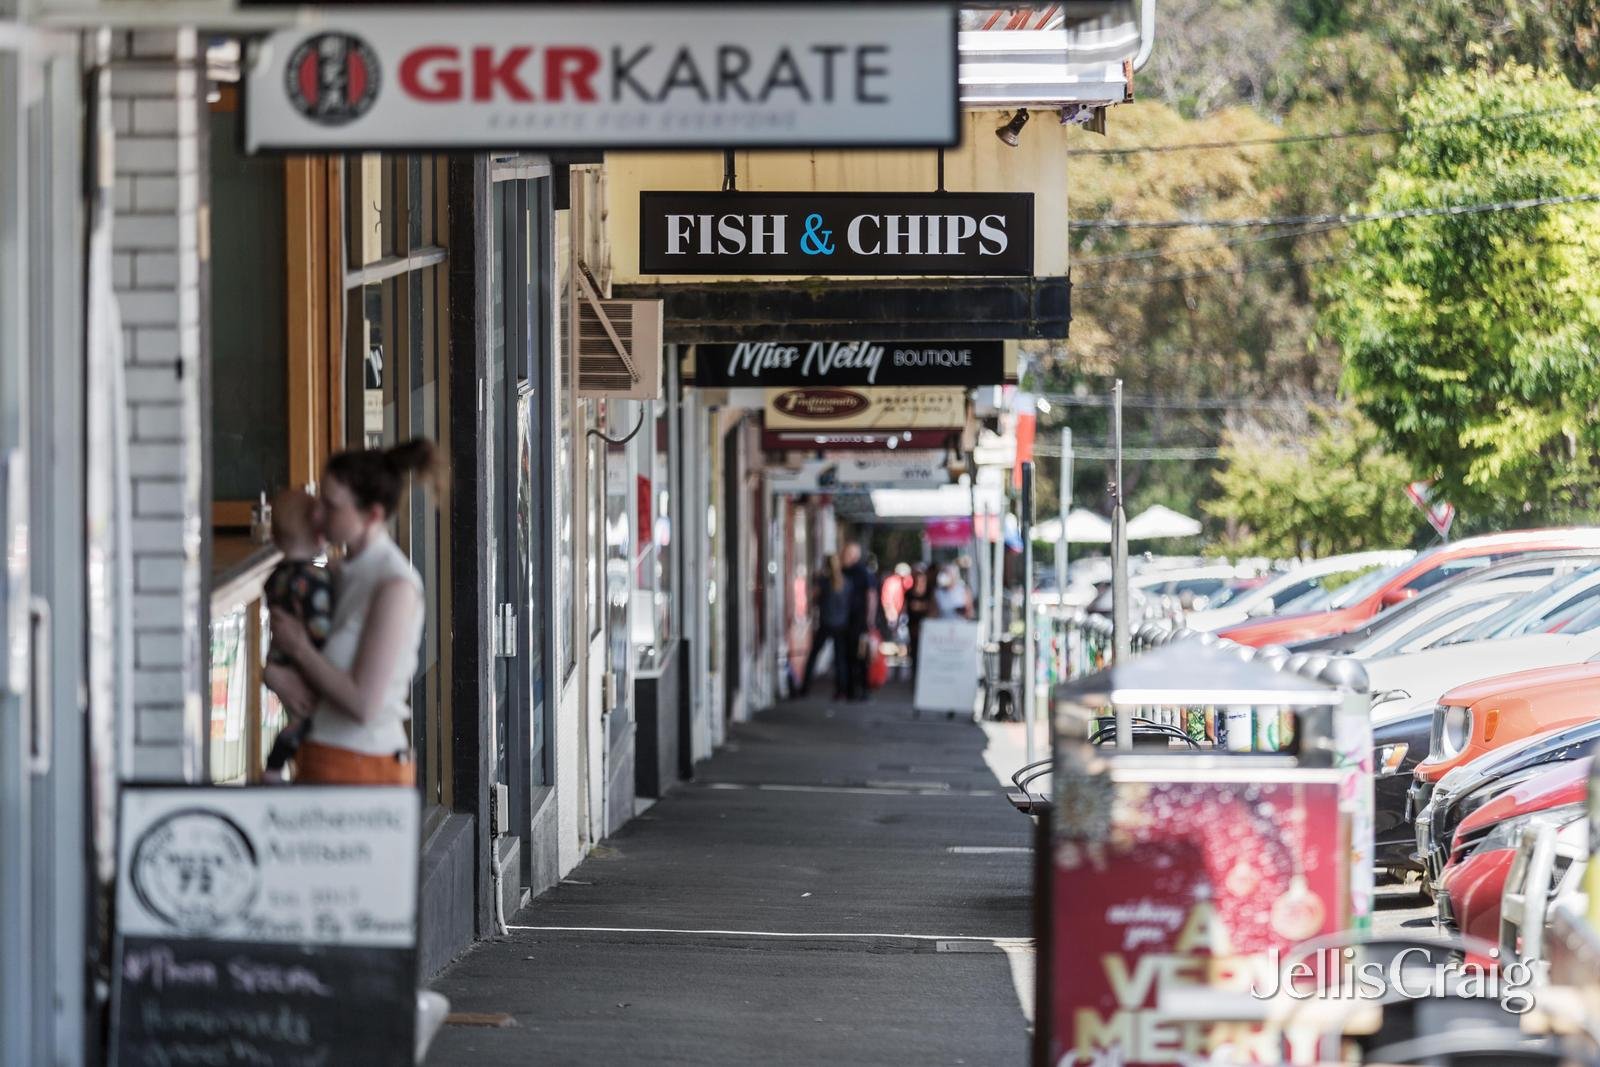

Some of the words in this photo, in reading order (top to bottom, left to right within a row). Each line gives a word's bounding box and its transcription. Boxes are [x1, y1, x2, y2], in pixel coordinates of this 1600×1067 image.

[664, 213, 789, 256] FISH
[799, 212, 836, 256] &
[847, 213, 1009, 257] CHIPS
[892, 349, 972, 367] BOUTIQUE
[1174, 897, 1234, 956] A
